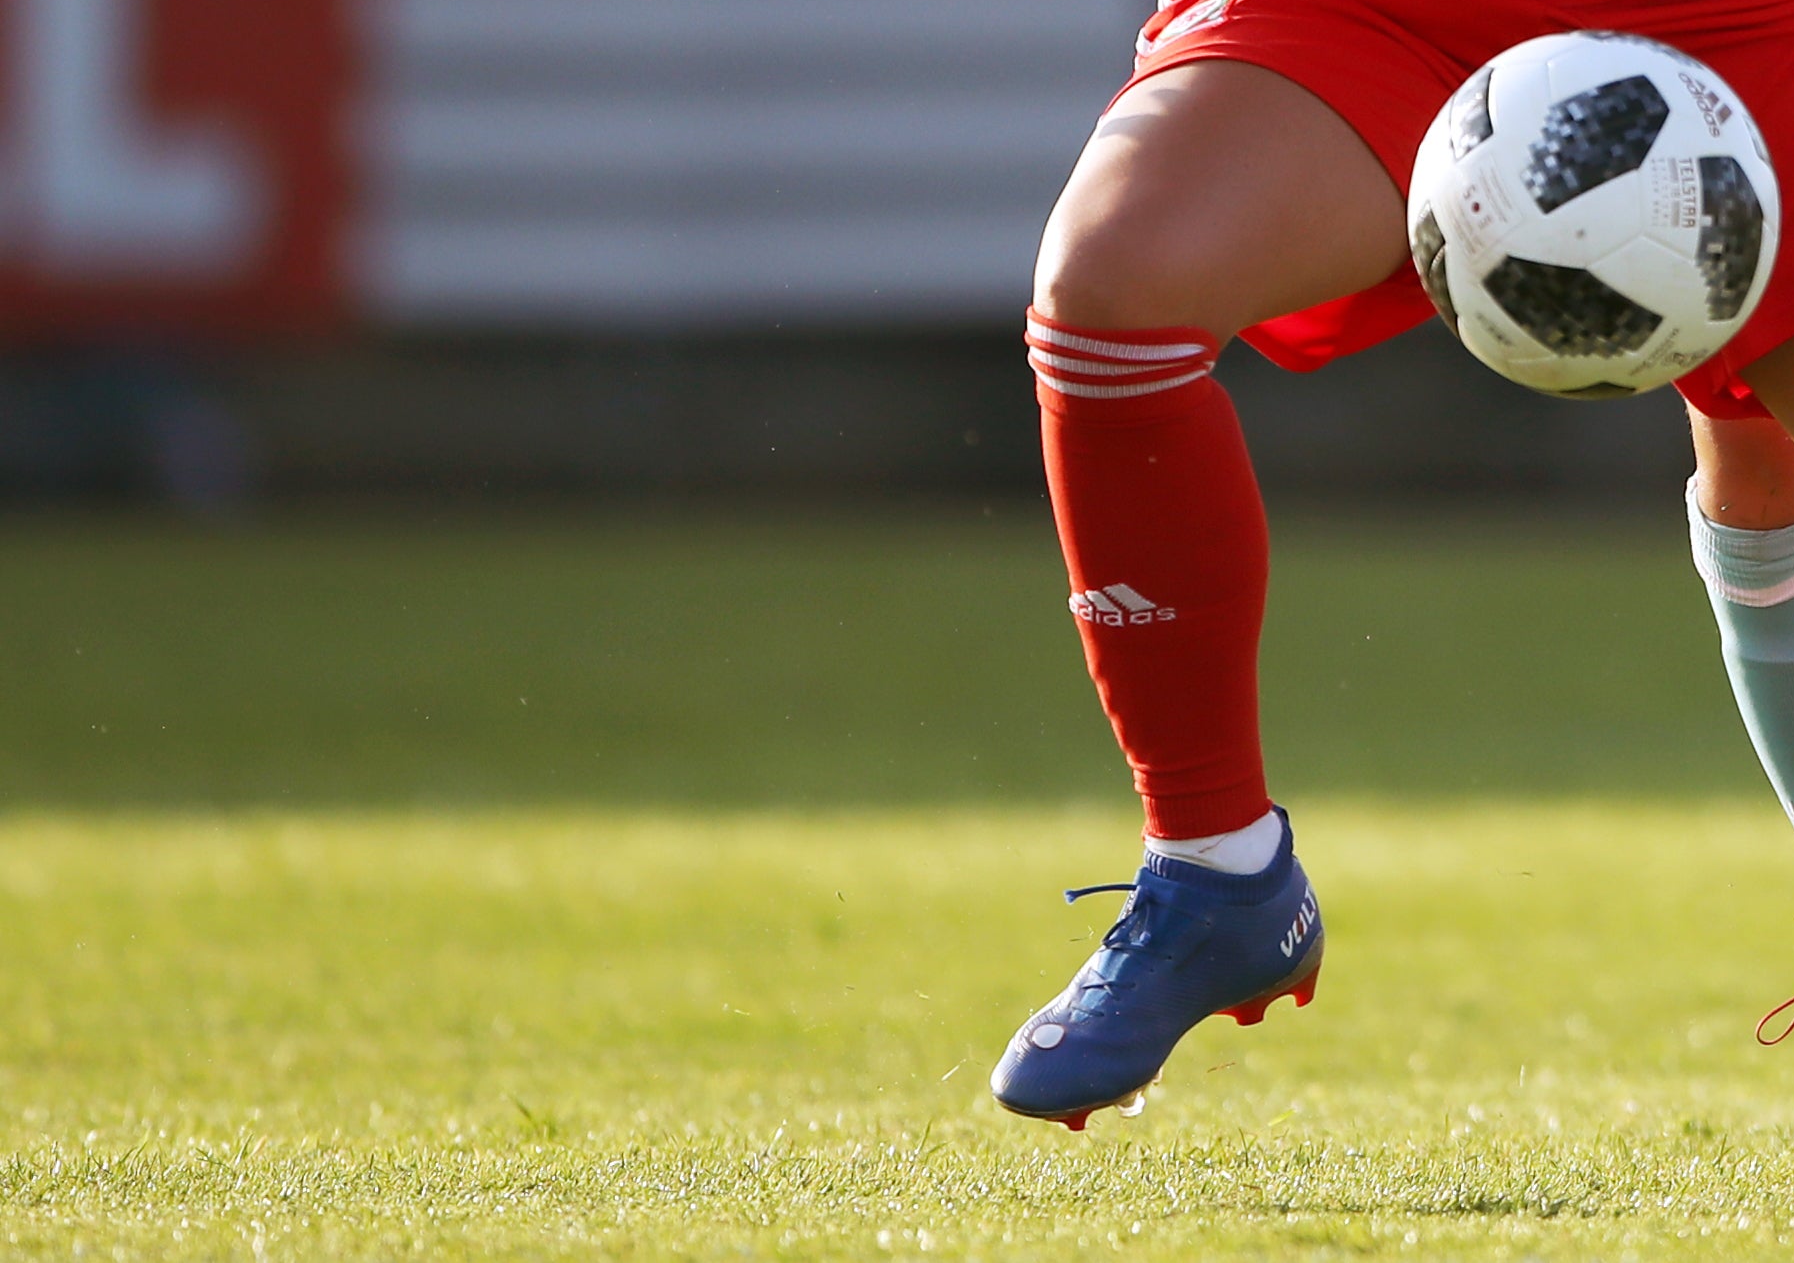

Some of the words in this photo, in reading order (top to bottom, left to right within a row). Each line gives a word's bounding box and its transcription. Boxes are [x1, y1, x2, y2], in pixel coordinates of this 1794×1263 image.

[1678, 72, 1721, 139] adidas
[1678, 156, 1697, 229] TELSTAR
[1068, 596, 1177, 627] adidas
